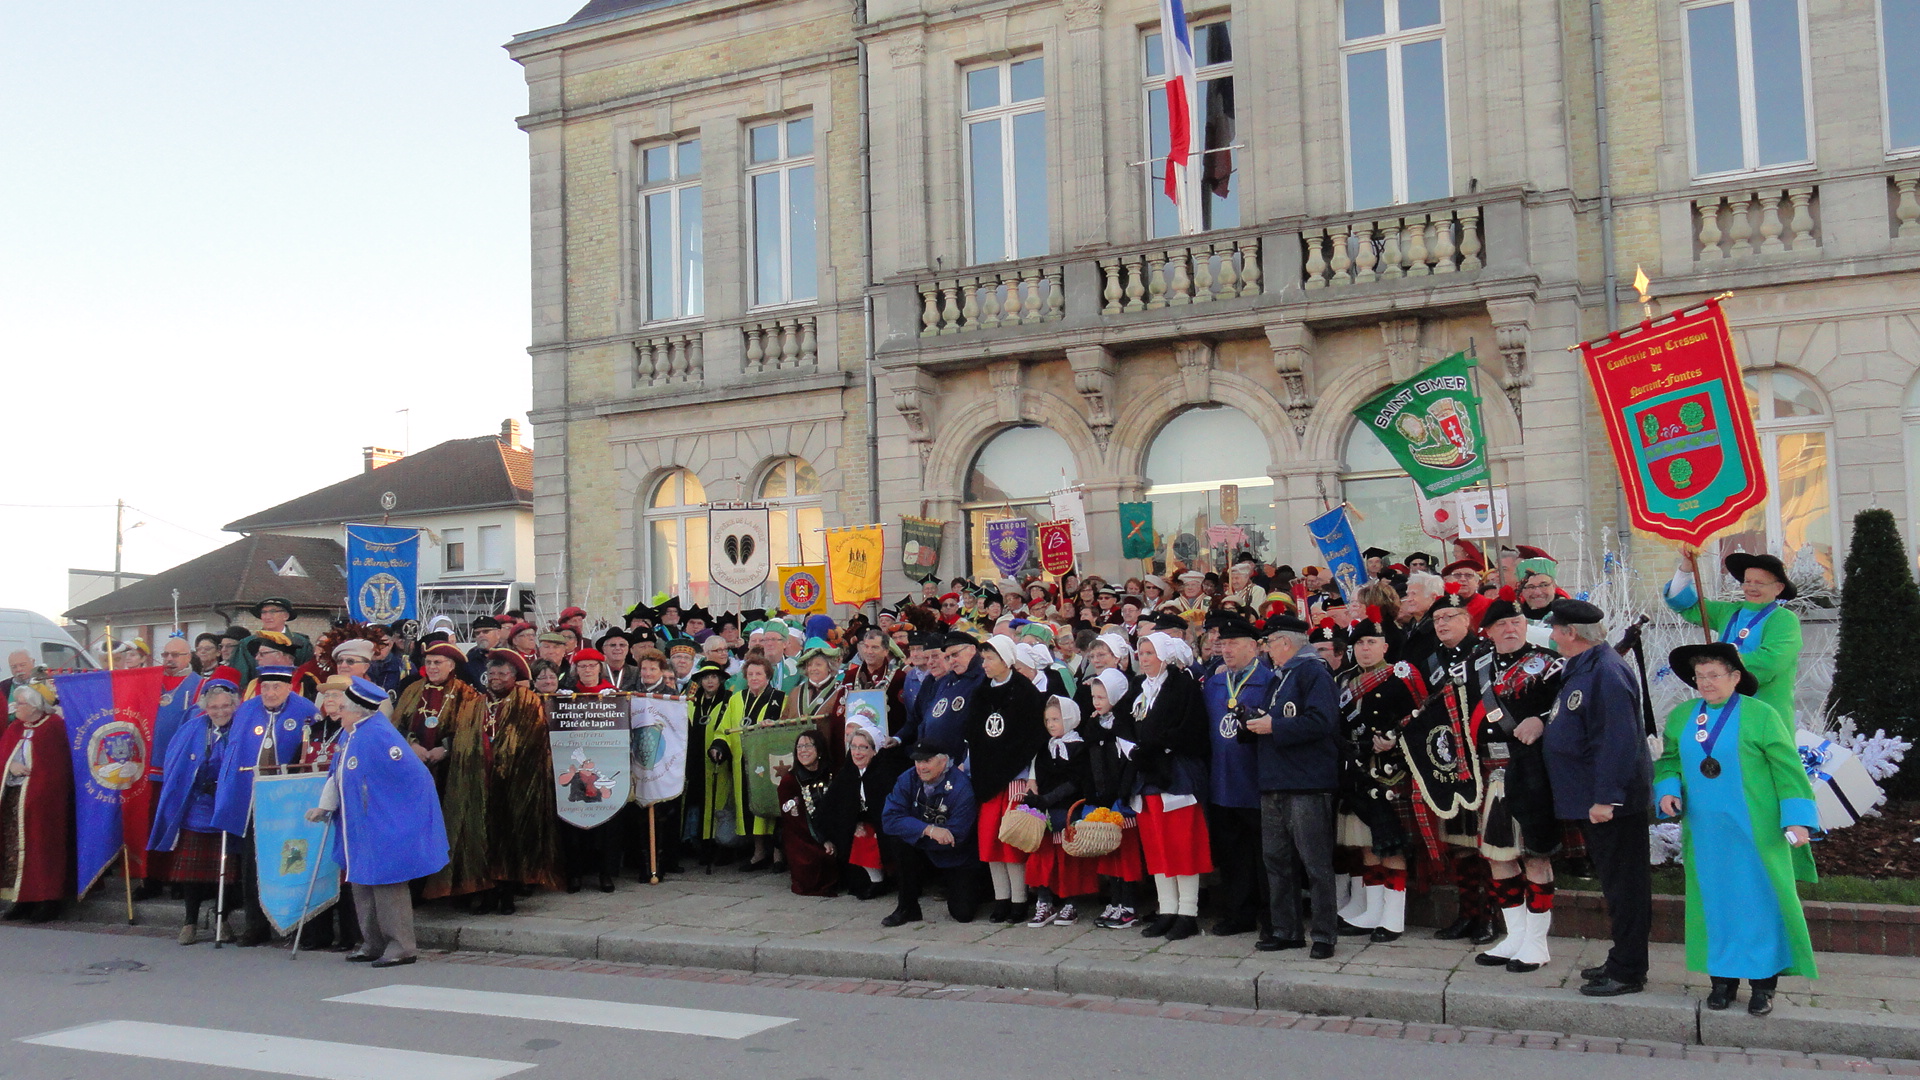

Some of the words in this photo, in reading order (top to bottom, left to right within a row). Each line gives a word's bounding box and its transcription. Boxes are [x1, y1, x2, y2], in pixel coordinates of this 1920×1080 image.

[1648, 345, 1663, 356] du
[1664, 332, 1708, 351] Cresson
[1650, 363, 1663, 373] de
[1629, 368, 1703, 399] Norrent-Fontes
[1374, 388, 1414, 429] SAINT
[1414, 375, 1467, 396] OMER
[1677, 500, 1700, 512] 2012
[990, 522, 1026, 531] ALENÇON
[558, 702, 577, 711] Plat
[576, 702, 588, 710] de
[587, 702, 617, 711] Tripes
[549, 711, 584, 720] Terrine
[584, 710, 626, 720] forestière
[559, 720, 579, 728] Pâté
[579, 720, 591, 728] de
[591, 720, 615, 729] lapin
